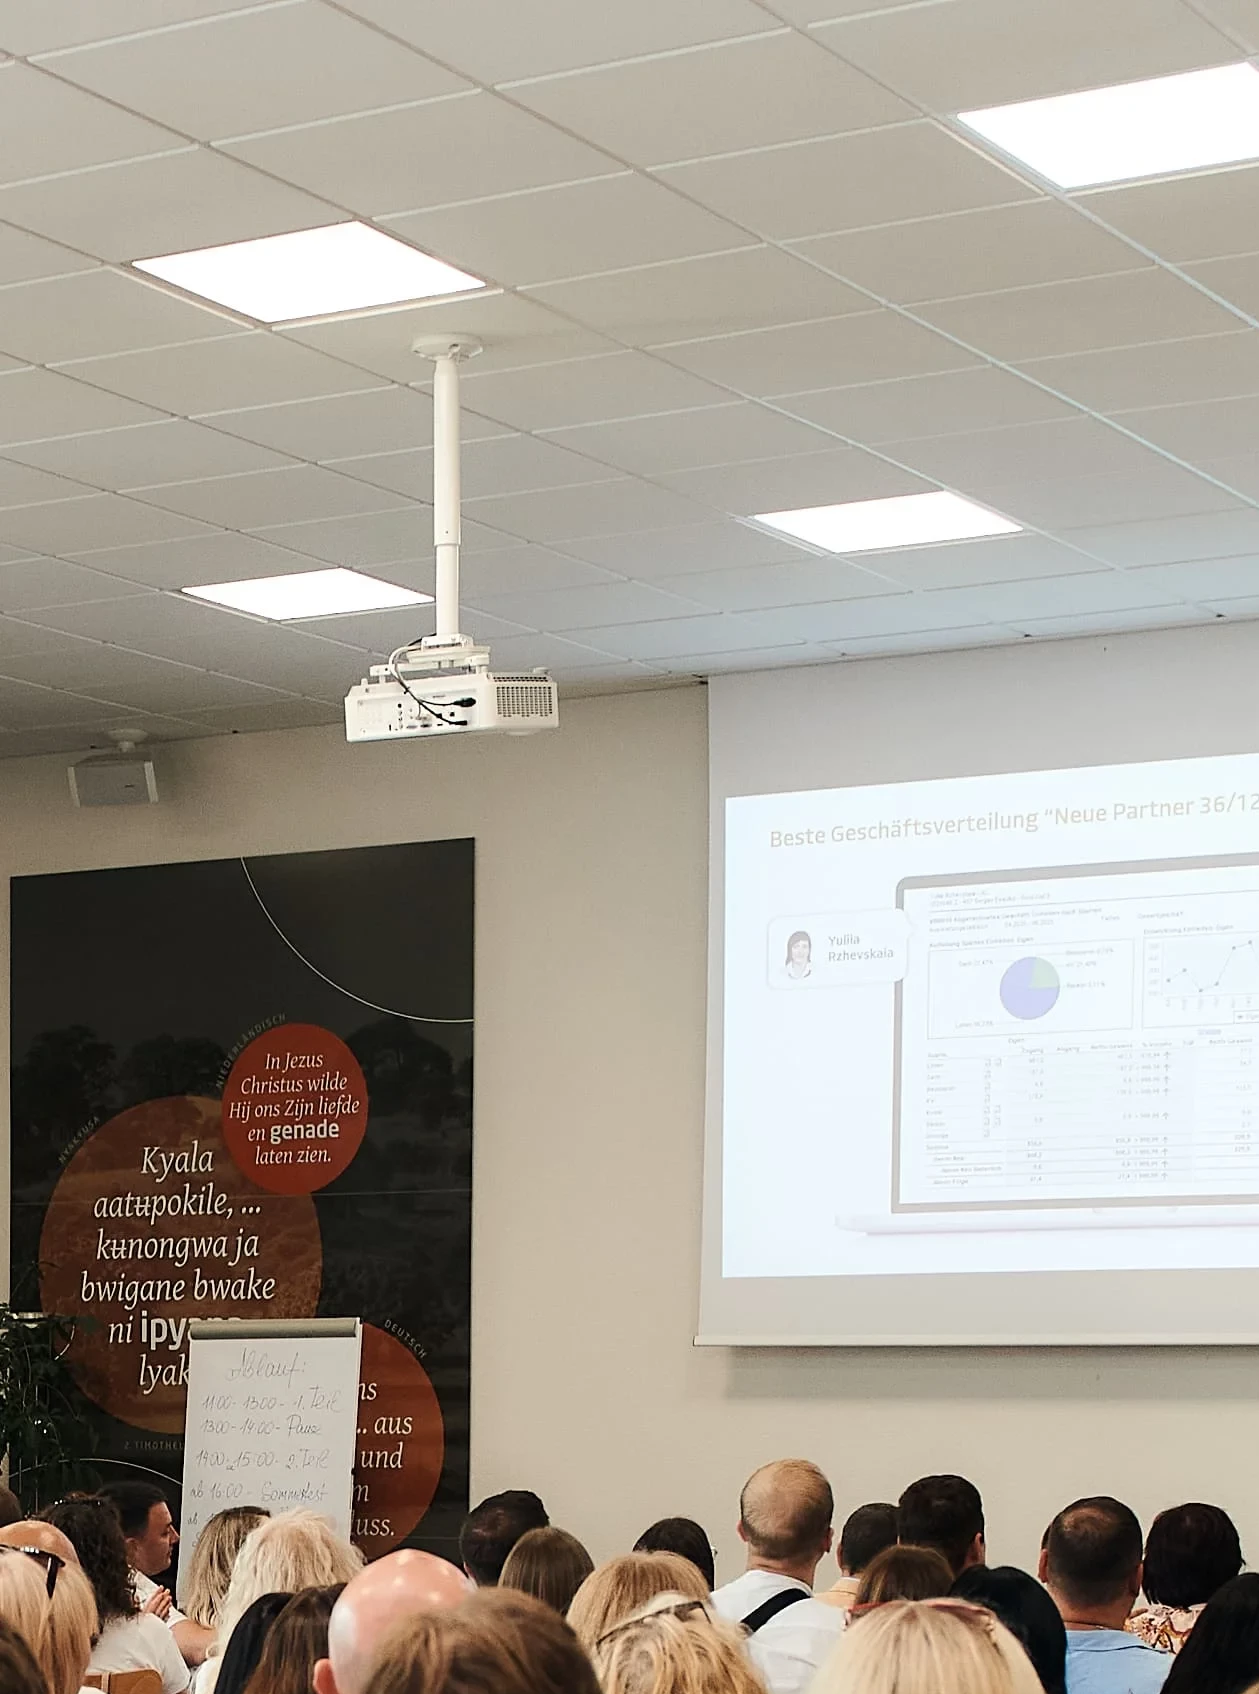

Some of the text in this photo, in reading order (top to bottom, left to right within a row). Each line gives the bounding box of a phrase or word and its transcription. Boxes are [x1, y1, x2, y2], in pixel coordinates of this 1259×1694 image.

[769, 829, 826, 848] Beste
[831, 810, 1039, 843] Geschäftsverteilung
[1113, 798, 1195, 821] Partner
[265, 1052, 324, 1073] In Jezus
[241, 1071, 348, 1095] Christus wilde
[229, 1094, 360, 1124] Hij ons Zijn liefde
[248, 1118, 340, 1145] en genade
[140, 1140, 214, 1183] Kyala
[255, 1145, 332, 1165] laten zien.
[228, 1228, 259, 1266] ja
[81, 1267, 276, 1310] bwigane bwake
[108, 1315, 134, 1344] ni
[139, 1354, 189, 1394] lyak
[374, 1416, 413, 1435] aus
[361, 1441, 403, 1469] und
